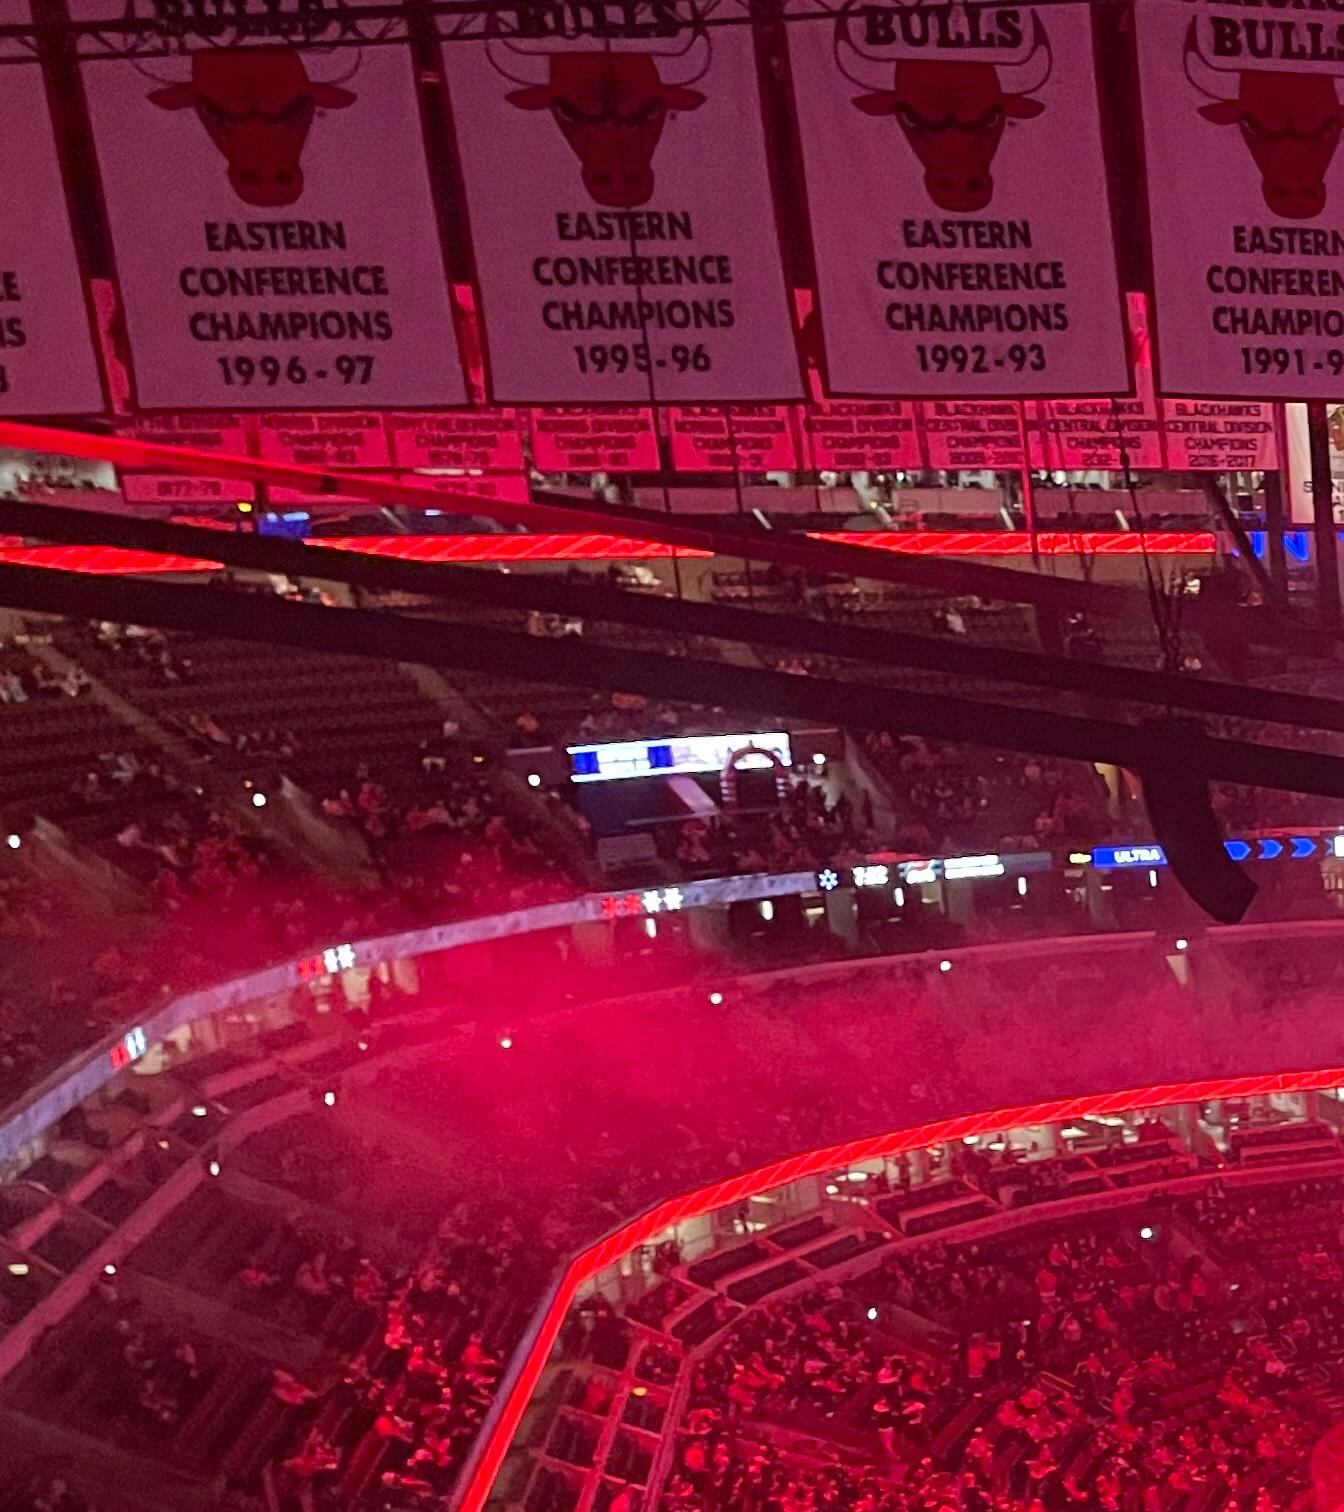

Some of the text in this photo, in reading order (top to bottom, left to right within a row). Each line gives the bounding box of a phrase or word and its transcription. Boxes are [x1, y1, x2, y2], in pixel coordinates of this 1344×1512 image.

[864, 8, 1024, 49] BULLS
[204, 221, 346, 251] EASTERN
[556, 211, 693, 240] EASTERN
[903, 220, 1033, 248] EASTERN
[180, 266, 389, 297] CONFERENCE
[532, 255, 733, 286] CONFERENCE
[876, 261, 1067, 291] CONFERENCE
[189, 311, 393, 342] CHAMPIONS
[541, 300, 735, 330] CHAMPIONS
[885, 303, 1069, 332] CHAMPIONS
[573, 344, 711, 373] 1995-96
[915, 344, 1046, 373] 1992-93
[1113, 850, 1160, 864] ULTRA
